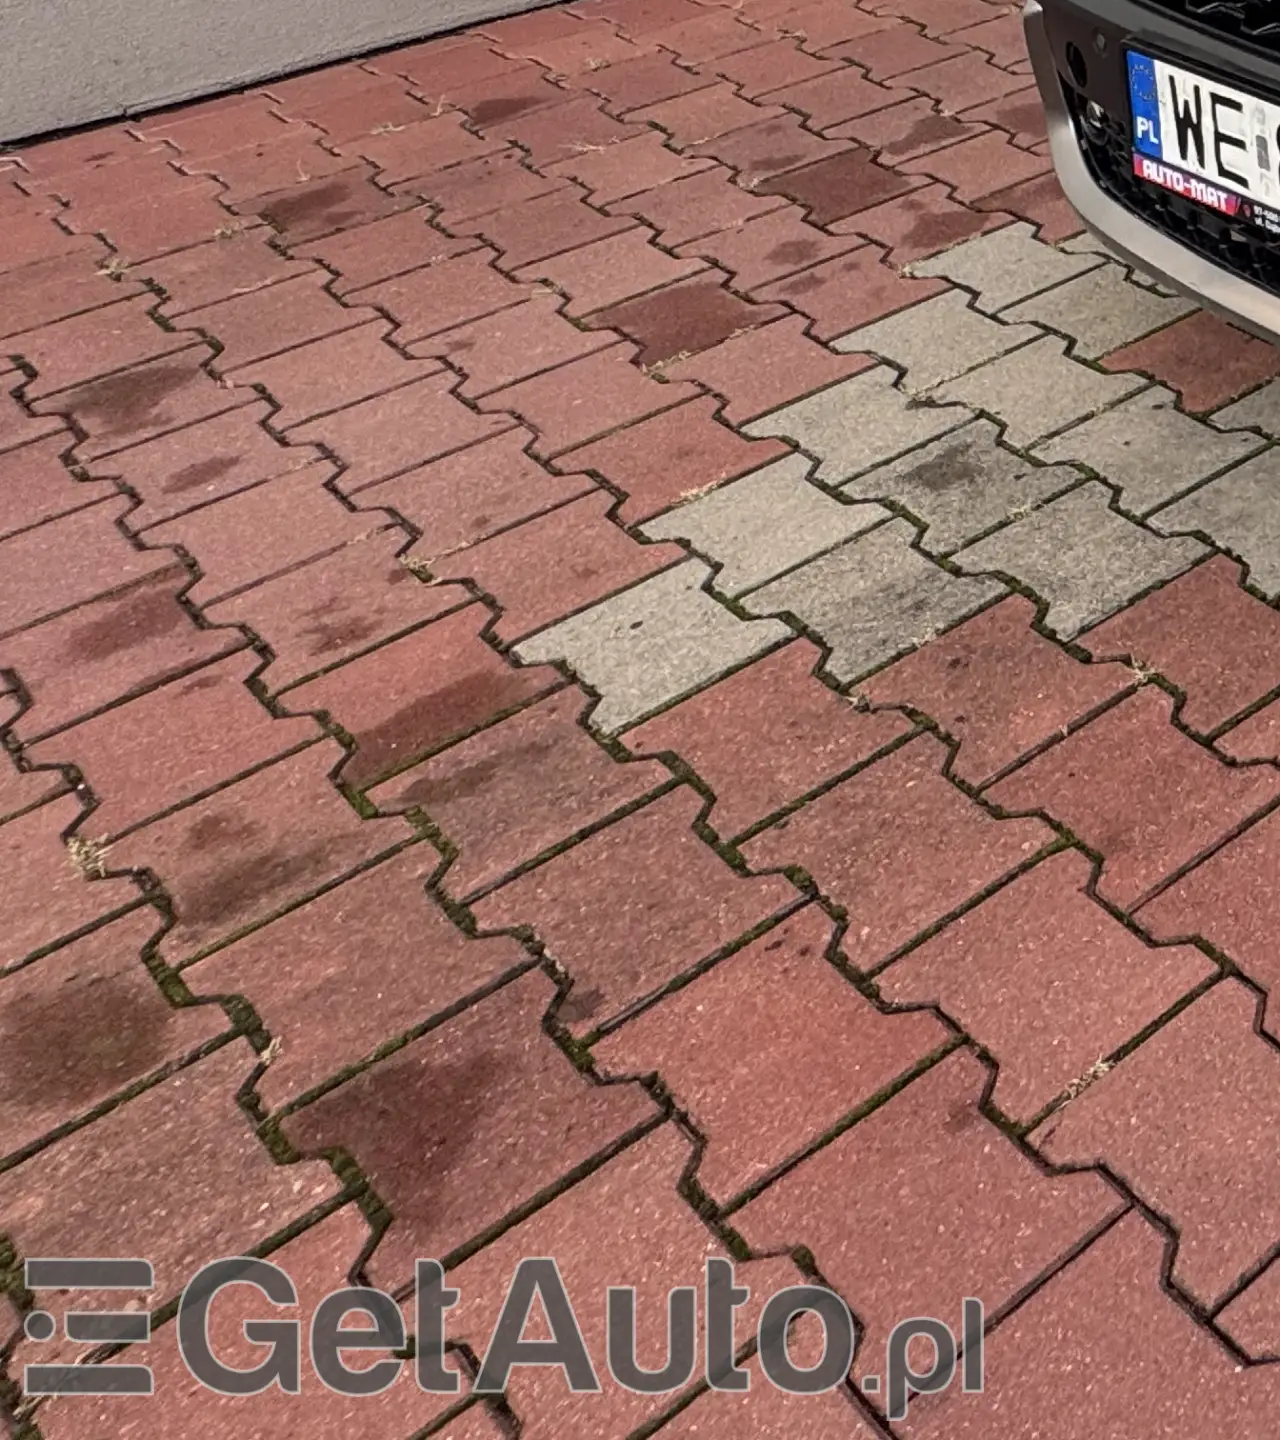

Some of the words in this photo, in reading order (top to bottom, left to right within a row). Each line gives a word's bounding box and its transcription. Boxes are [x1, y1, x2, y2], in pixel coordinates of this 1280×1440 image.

[1136, 116, 1159, 145] PL
[1168, 74, 1250, 191] WE
[1142, 159, 1228, 212] AUTO-MAT
